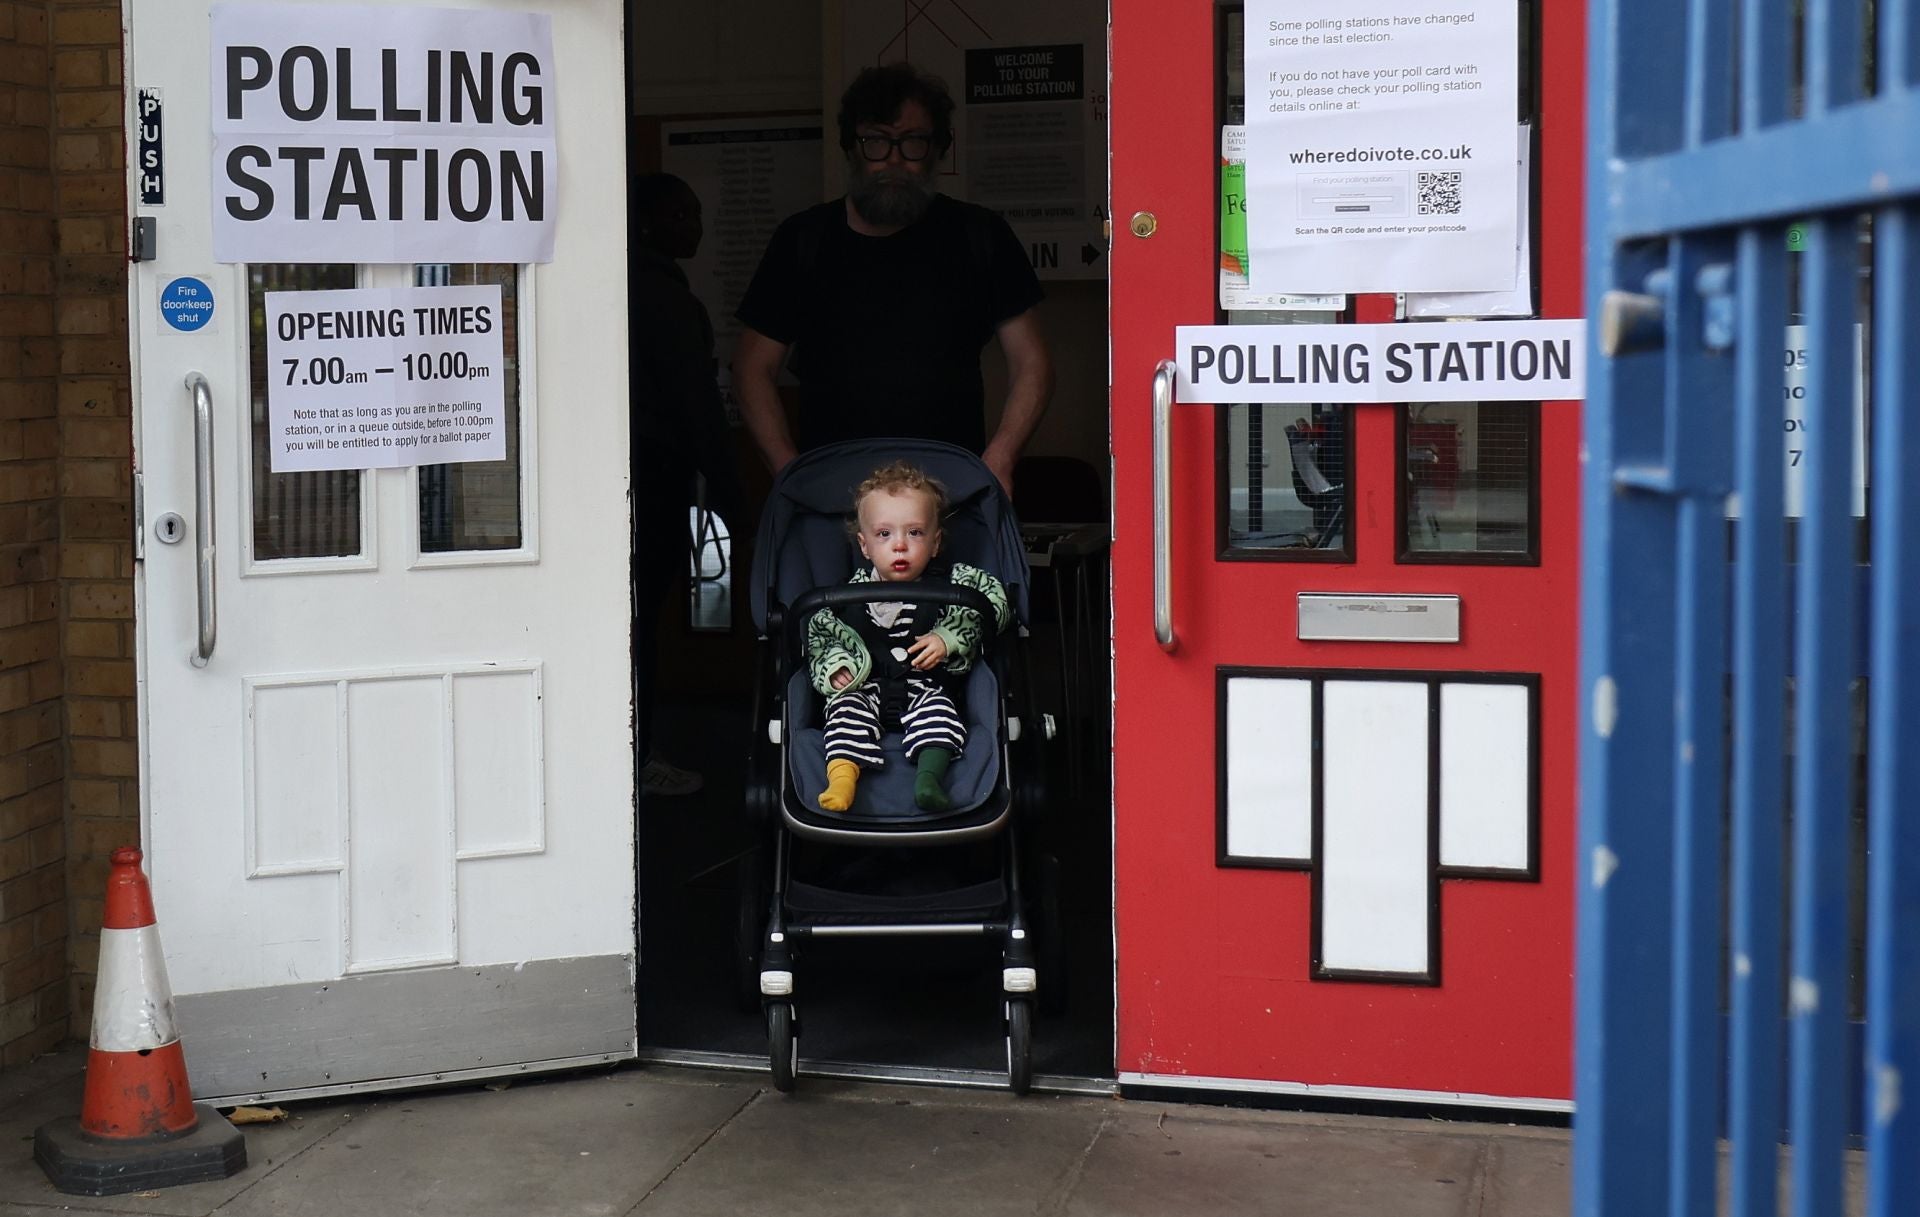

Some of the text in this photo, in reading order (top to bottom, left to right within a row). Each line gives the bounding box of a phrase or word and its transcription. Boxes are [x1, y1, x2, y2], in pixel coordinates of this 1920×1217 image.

[1269, 12, 1475, 32] Some polling stations have changed
[1269, 32, 1394, 46] since the last election.
[994, 52, 1054, 67] WELCOME
[1000, 68, 1049, 81] TO YOUR
[1269, 64, 1478, 84] If you do not have your poll card with
[226, 45, 543, 126] POLLING
[974, 81, 1076, 97] POLLING STATION
[1269, 80, 1482, 100] you, please check your polling station
[1269, 100, 1360, 113] details online at:
[143, 99, 161, 193] PUSH
[1289, 144, 1472, 164] wheredoivote.co.uk
[225, 145, 544, 222] STATION
[1045, 206, 1075, 217] VOTING
[1295, 227, 1314, 235] Scan
[1330, 226, 1343, 234] QR
[1345, 226, 1365, 234] code
[1407, 226, 1426, 234] your
[1427, 224, 1467, 234] postcode
[1032, 242, 1058, 268] IN
[177, 286, 197, 296] Fire
[177, 312, 198, 322] shut
[277, 305, 492, 342] OPENING TIMES
[282, 356, 368, 386] 7.00am
[402, 351, 490, 381] 10.00pm
[1191, 339, 1572, 385] POLLING STATION
[293, 401, 482, 420] Note that as long as you are in the polling
[285, 416, 494, 436] station, or in a queue outside, before 10.00pm
[285, 431, 491, 453] you will be entitled to apply for a ballot paper
